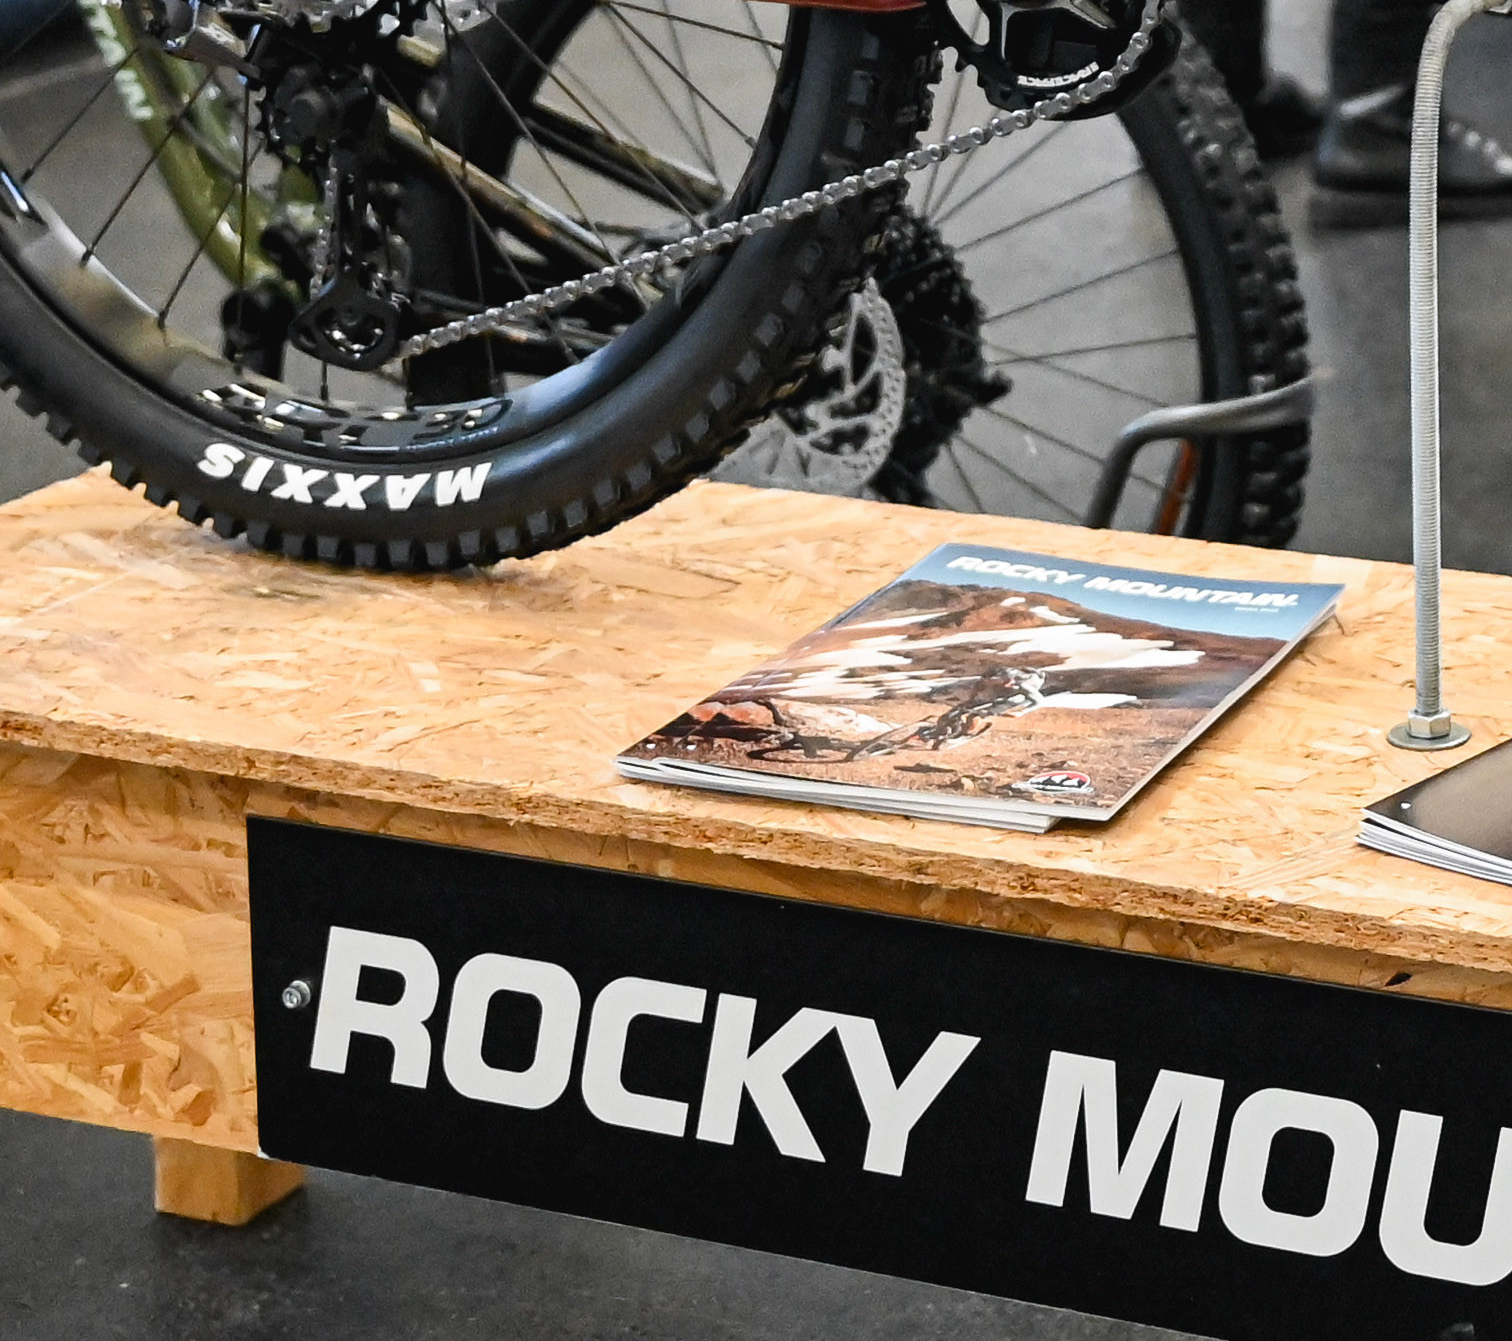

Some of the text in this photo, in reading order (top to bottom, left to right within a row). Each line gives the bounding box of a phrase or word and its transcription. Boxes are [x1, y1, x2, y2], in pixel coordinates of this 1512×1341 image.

[197, 442, 492, 510] MAXXIS
[946, 555, 1086, 584] ROCKY
[308, 926, 982, 1179] ROCKY
